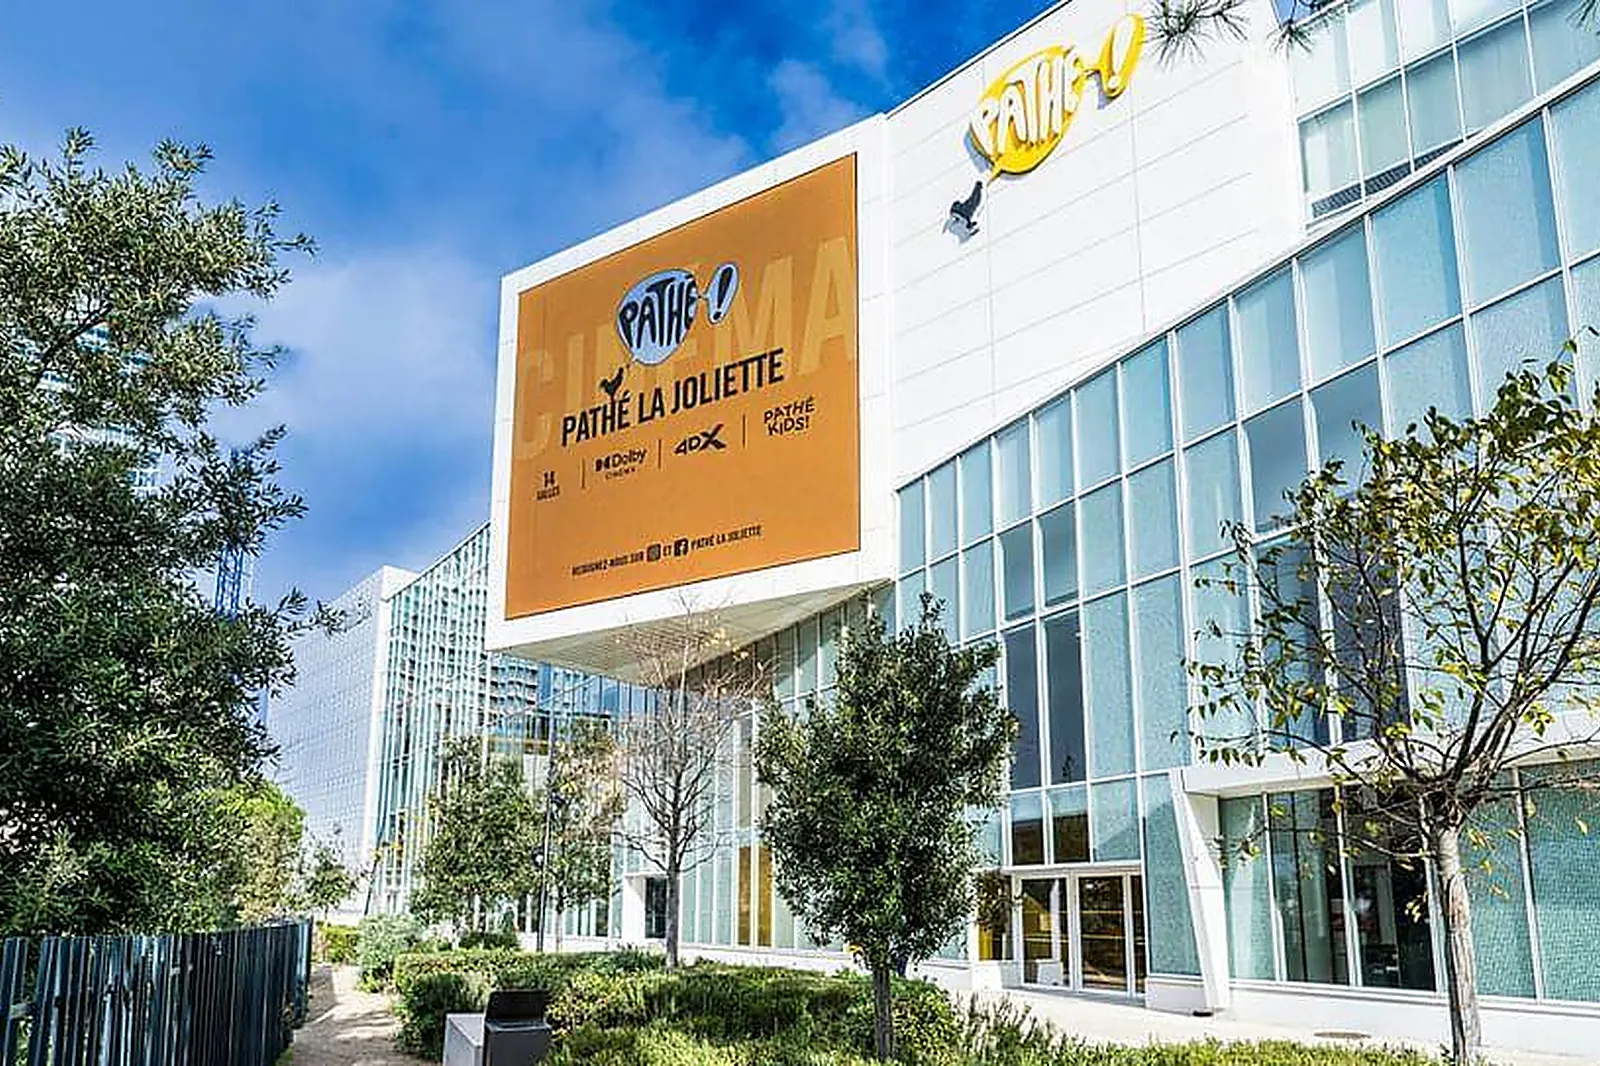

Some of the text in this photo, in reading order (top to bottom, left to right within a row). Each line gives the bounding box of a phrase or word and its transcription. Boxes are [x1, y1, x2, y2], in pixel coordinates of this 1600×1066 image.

[562, 348, 784, 447] PATHÉ LA JOLIETTE
[766, 415, 809, 436] KIDS!
[674, 423, 727, 455] 4DX
[611, 448, 647, 467] Dolby
